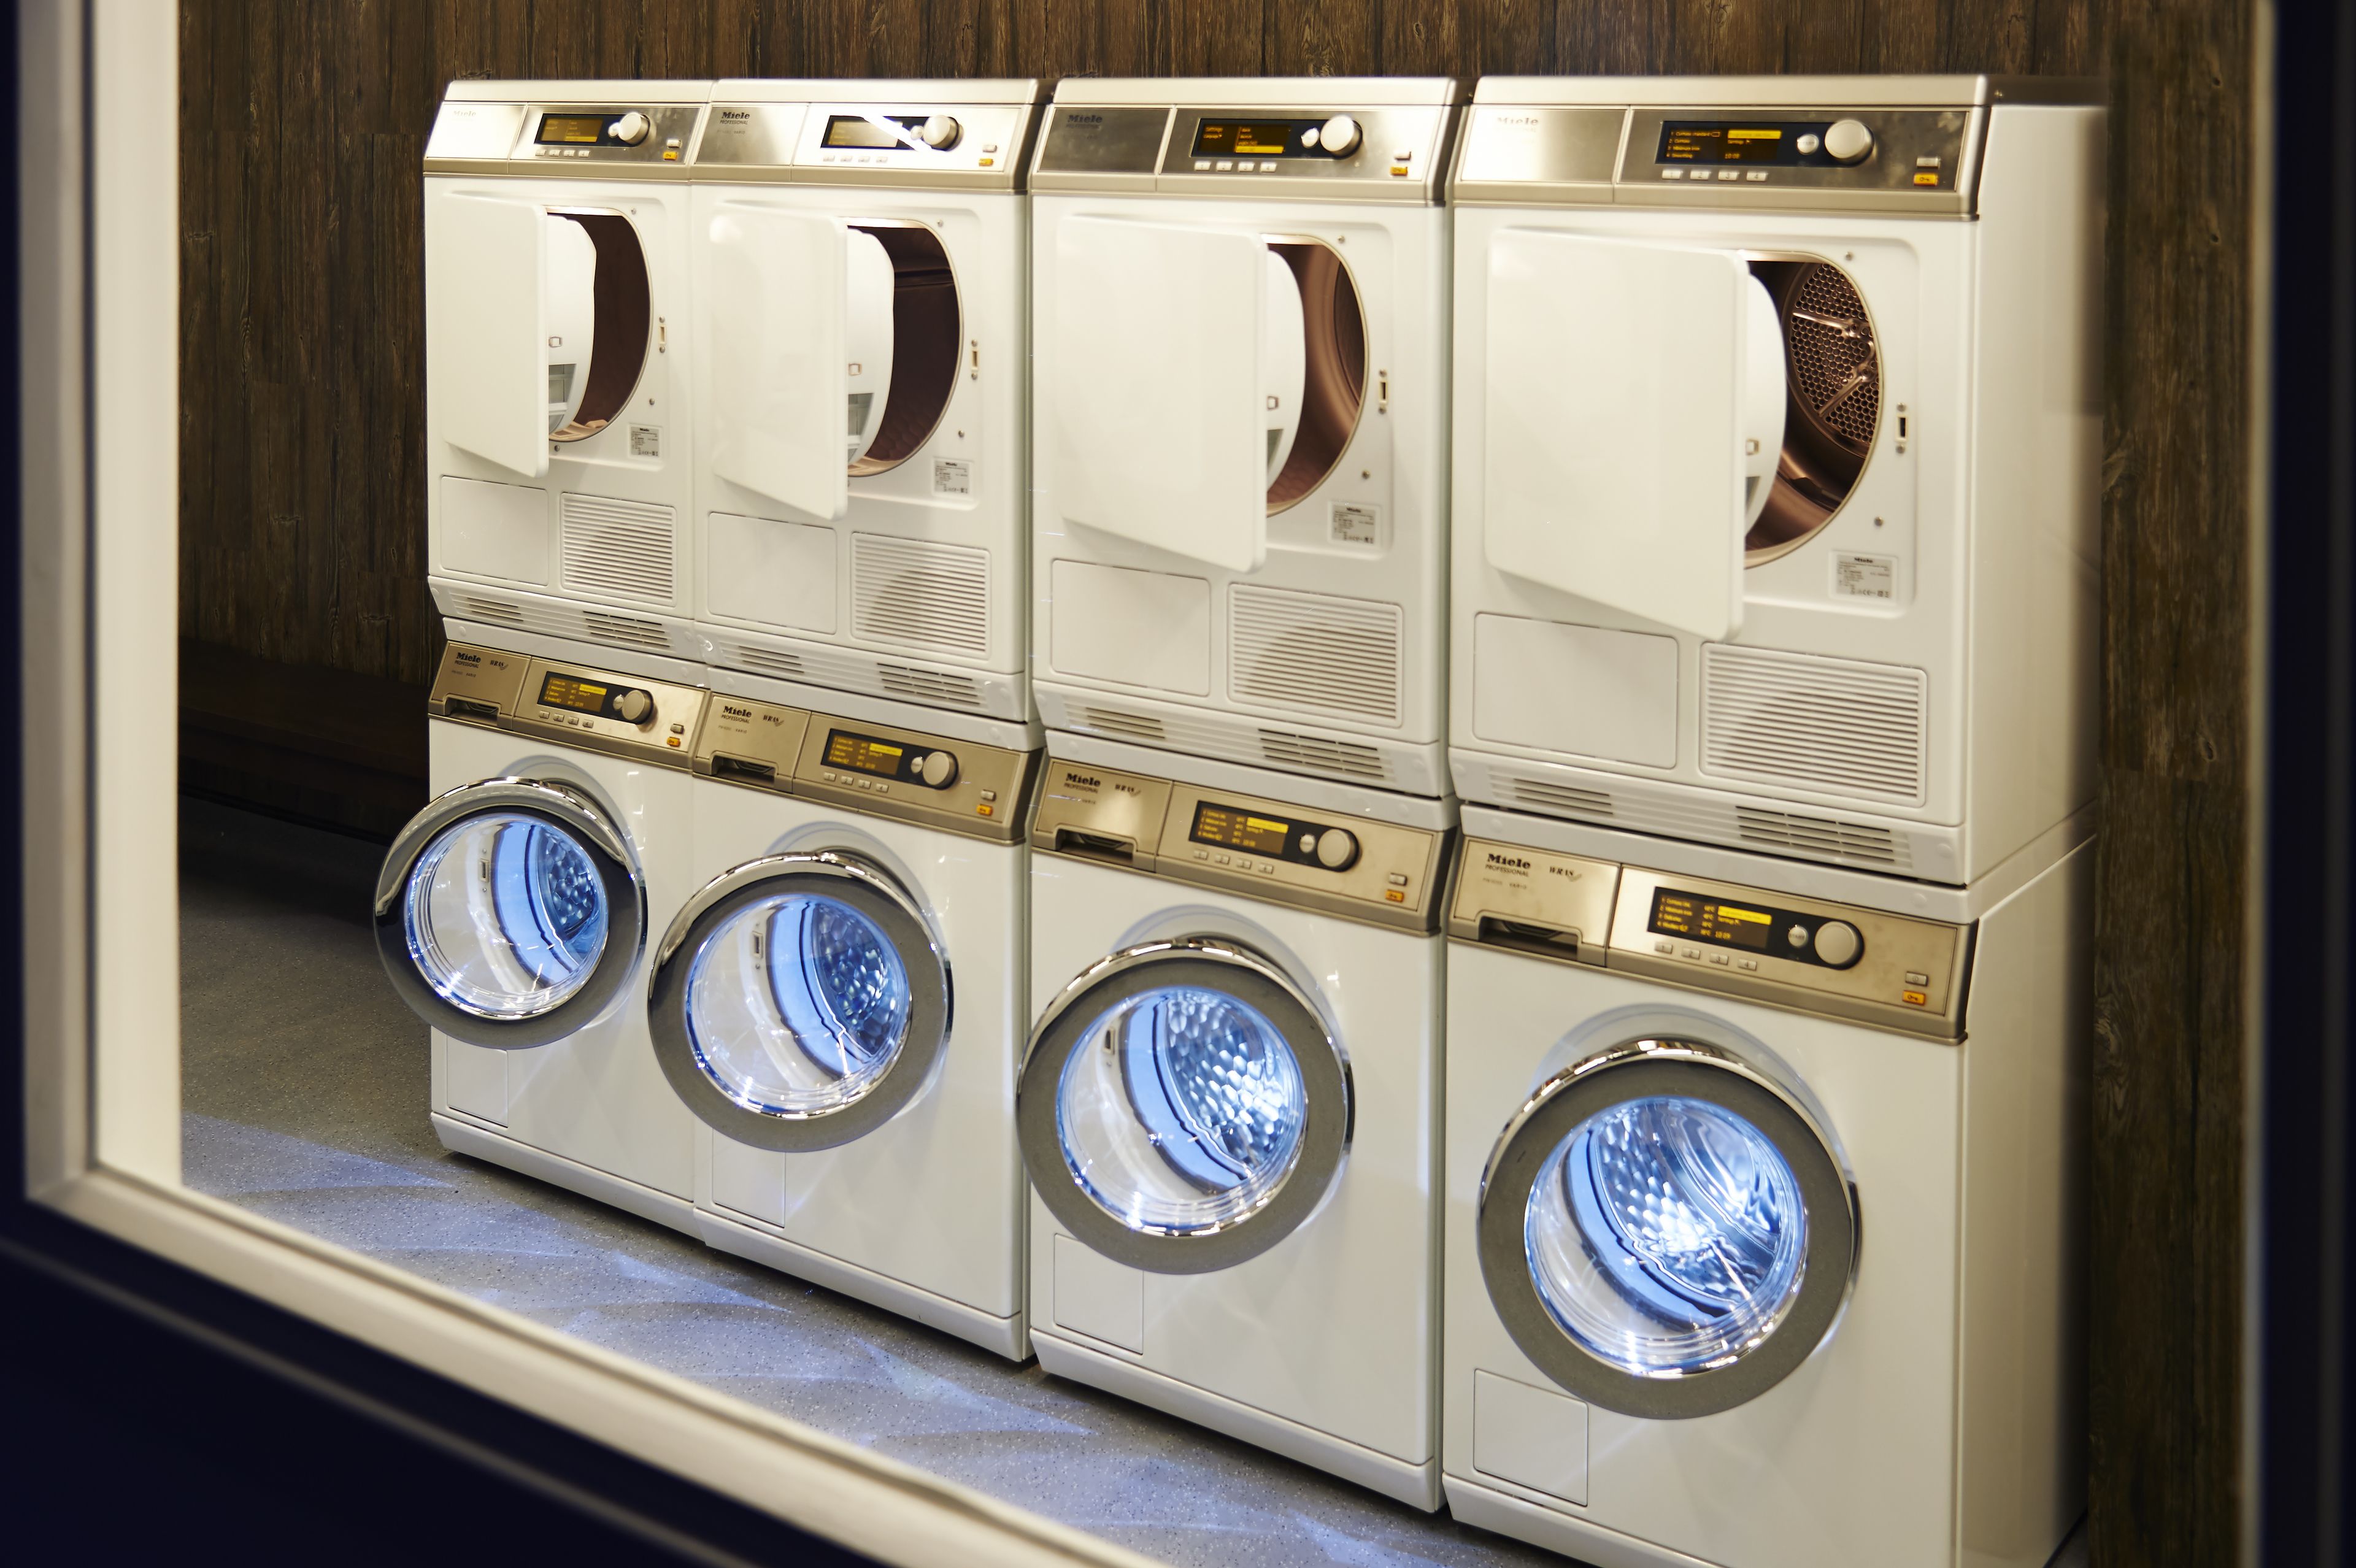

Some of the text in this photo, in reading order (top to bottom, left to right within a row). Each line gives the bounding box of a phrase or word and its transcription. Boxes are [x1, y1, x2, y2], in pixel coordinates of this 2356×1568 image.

[455, 659, 479, 669] PROFESSIONAL
[456, 652, 482, 663] Miele
[723, 705, 752, 718] Miele
[721, 714, 750, 724] PROFESSIONAL
[1066, 772, 1101, 787] Miele
[1487, 853, 1531, 869] Miele
[1485, 864, 1529, 877] PROFESSIONAL
